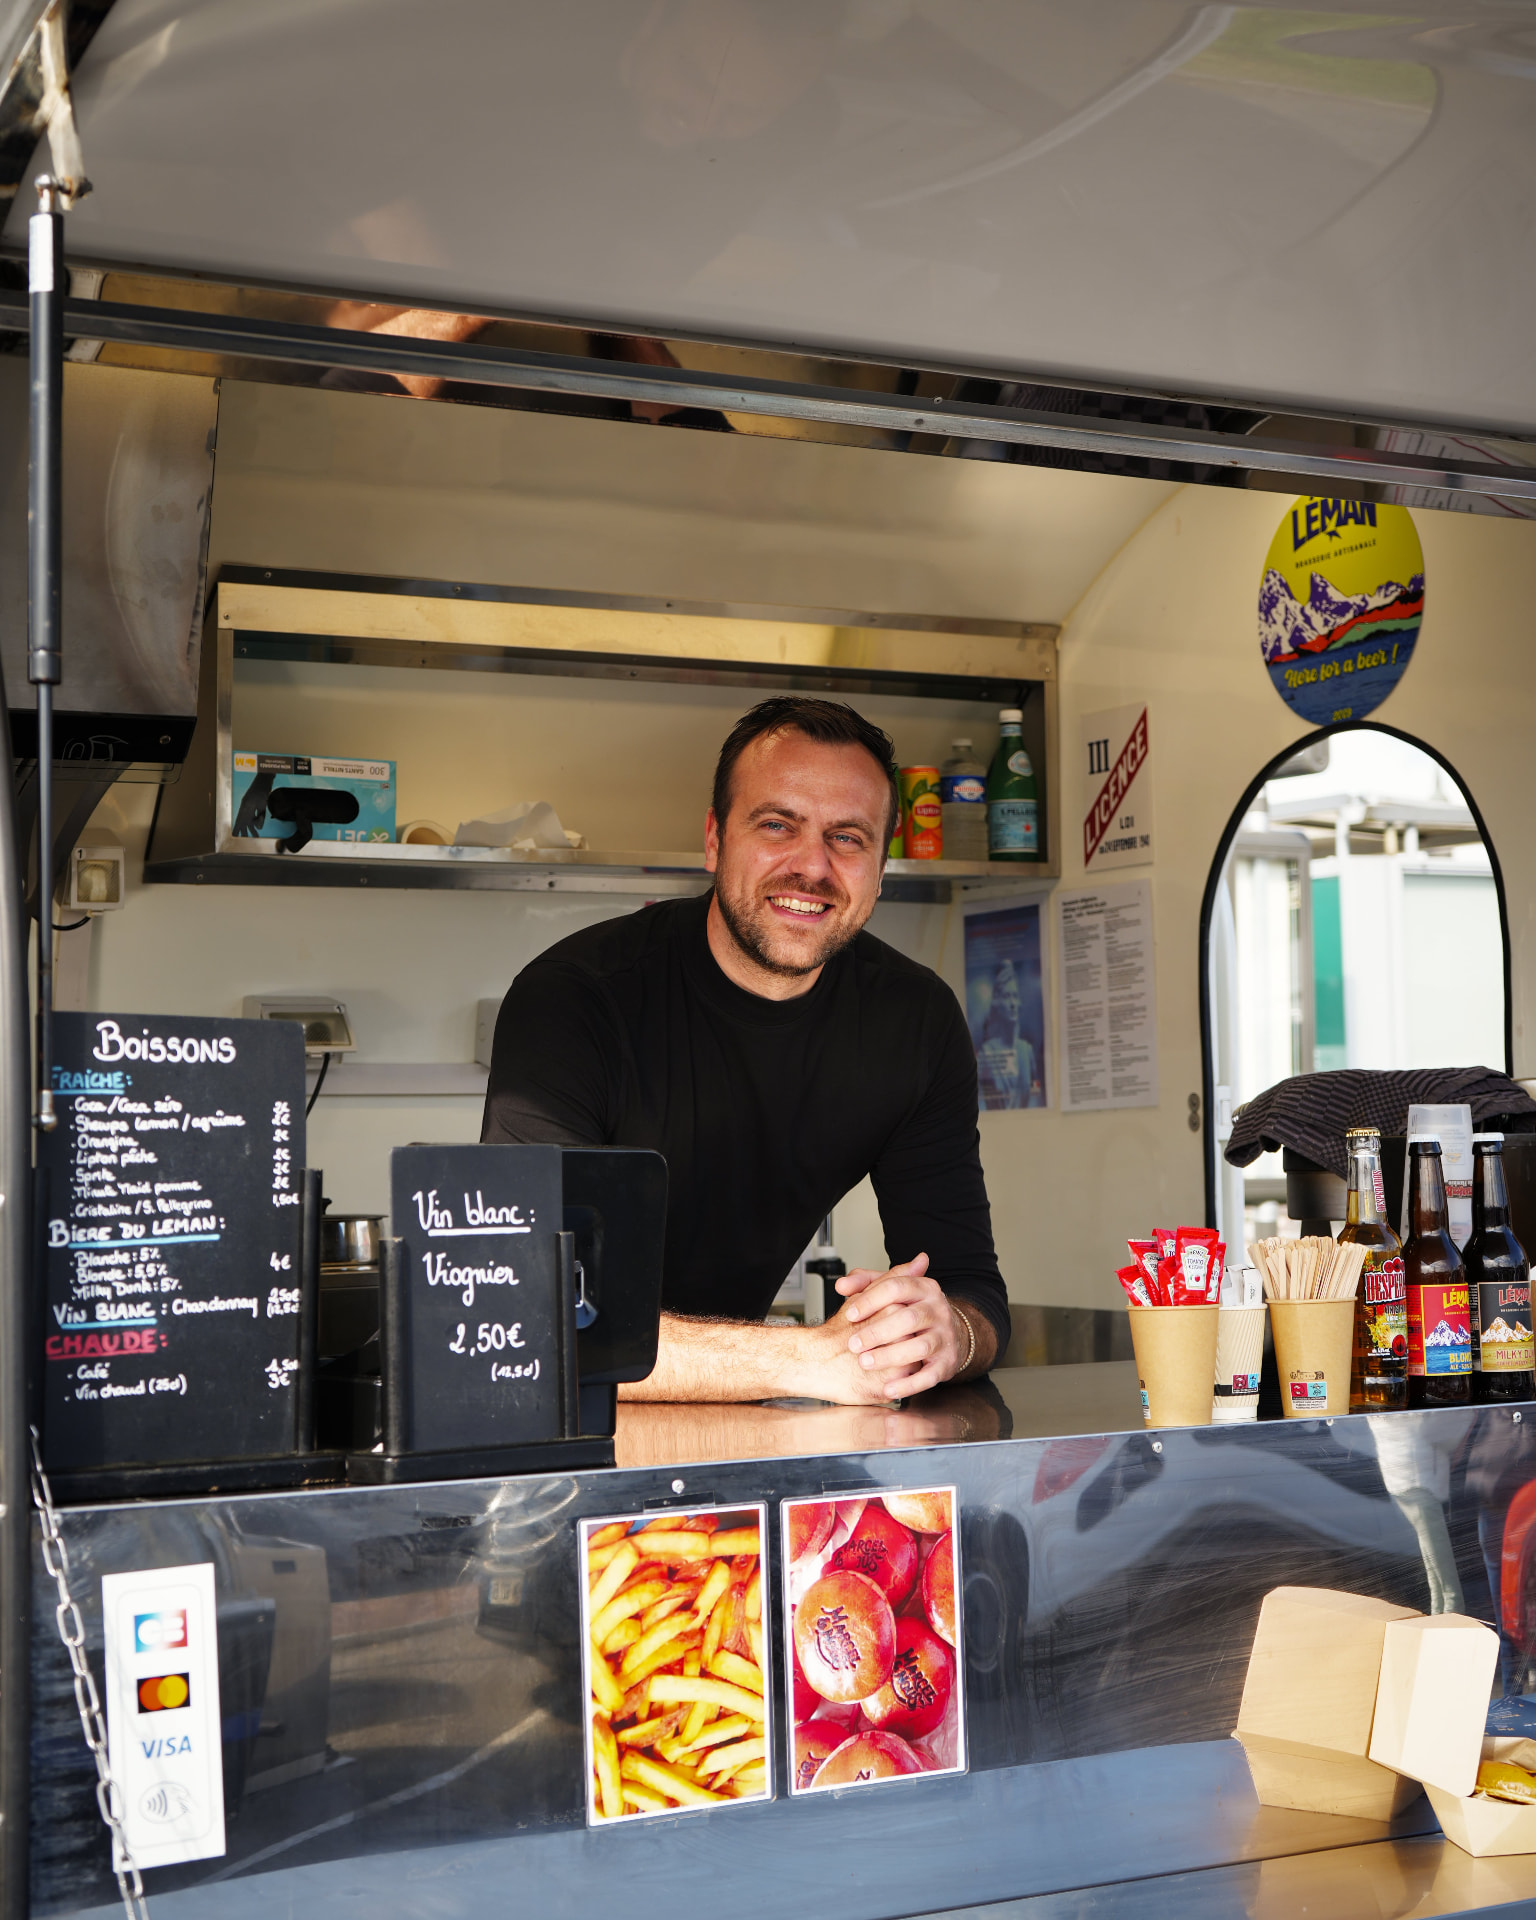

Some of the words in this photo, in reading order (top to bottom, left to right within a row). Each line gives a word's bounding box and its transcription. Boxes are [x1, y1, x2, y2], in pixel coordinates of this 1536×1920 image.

[1292, 496, 1378, 552] LÉMAN
[1295, 552, 1332, 569] BRASSERIE
[1333, 538, 1377, 558] ARTISANALE
[1284, 667, 1319, 688] Here
[1320, 661, 1342, 681] for
[1343, 659, 1354, 673] a
[1356, 649, 1388, 670] beer
[369, 766, 386, 776] 300
[1086, 719, 1147, 856] LICENCE
[77, 1133, 139, 1153] Orangina
[76, 1149, 118, 1169] Lipton
[75, 1167, 116, 1187] Sprite
[154, 1180, 202, 1196] pomme
[412, 1190, 453, 1231] Vin
[119, 1223, 146, 1239] DU
[270, 1252, 291, 1271] 4€
[422, 1252, 520, 1307] Viognier
[171, 1297, 258, 1318] Chardonnay
[449, 1322, 526, 1357] 2,50€
[1496, 1350, 1522, 1360] MILKY
[267, 1372, 291, 1389] 3€
[75, 1383, 99, 1400] Vin
[140, 1735, 193, 1760] VISA
